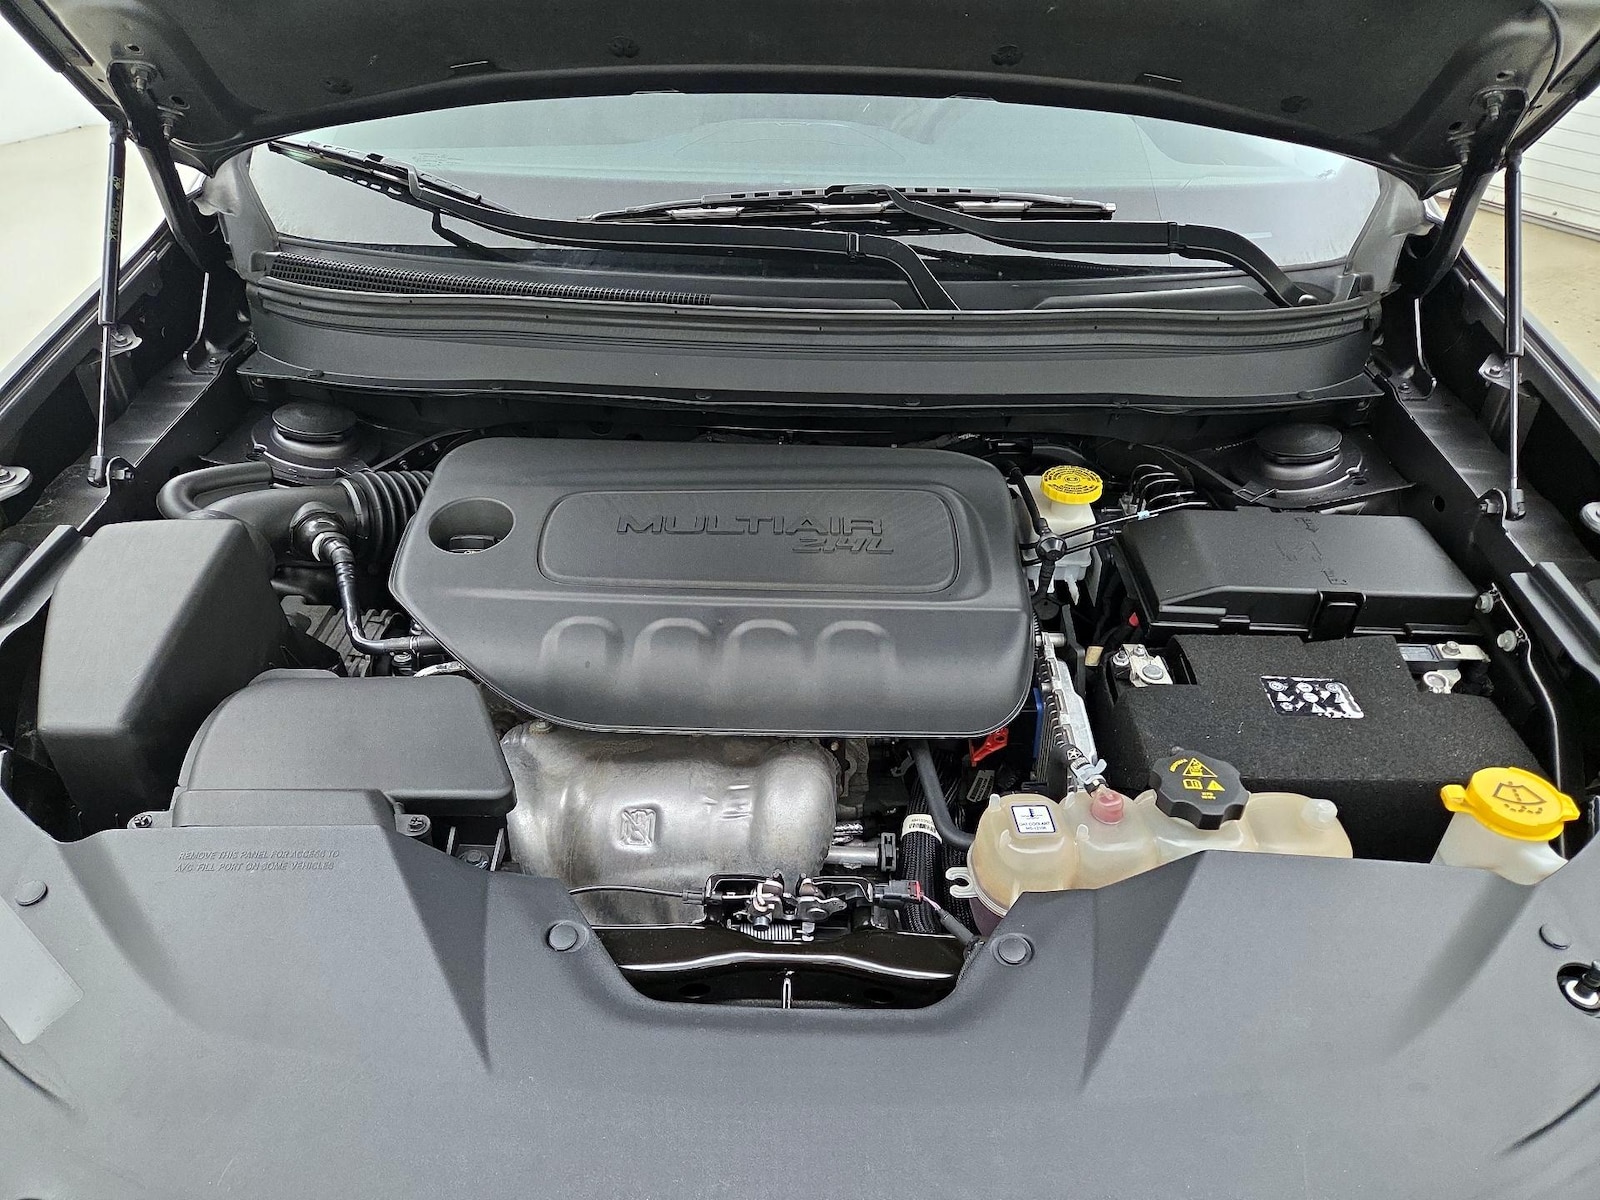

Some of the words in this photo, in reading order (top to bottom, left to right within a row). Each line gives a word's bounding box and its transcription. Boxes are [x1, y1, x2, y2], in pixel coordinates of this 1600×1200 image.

[616, 514, 884, 536] MULTIAIR
[178, 851, 216, 861] REMOVE
[217, 850, 239, 860] THIS
[240, 850, 268, 860] PANEL
[270, 850, 290, 859] FOR
[290, 849, 326, 859] ACCESS
[327, 849, 340, 858] TO
[174, 863, 194, 873] A/C
[196, 862, 215, 872] FILL
[217, 862, 244, 872] PORT
[245, 861, 260, 871] ON
[261, 861, 288, 871] SOME
[290, 860, 335, 870] VEHICLES
